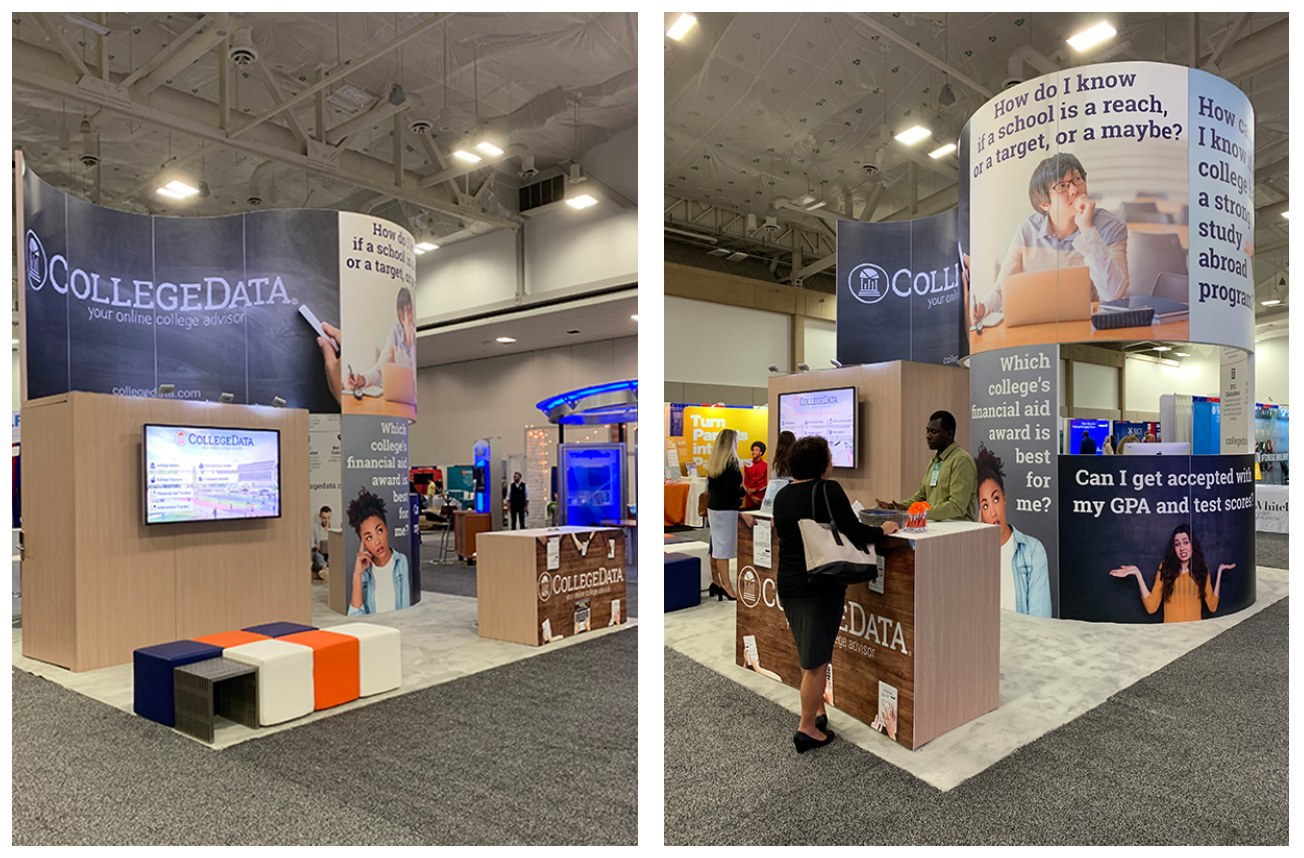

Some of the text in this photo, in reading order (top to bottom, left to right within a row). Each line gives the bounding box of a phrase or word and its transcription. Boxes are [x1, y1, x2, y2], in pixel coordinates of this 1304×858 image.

[993, 72, 1136, 119] How do I know
[1198, 95, 1236, 127] How
[977, 94, 1168, 154] if a school is a reach,
[973, 120, 1183, 178] or a target, or a maybe?
[1198, 126, 1247, 164] I know
[1198, 160, 1248, 195] college
[1198, 191, 1210, 208] a
[373, 222, 396, 240] How
[1198, 220, 1243, 251] study
[353, 237, 374, 253] if a
[346, 258, 372, 271] or a
[1198, 248, 1248, 278] abroad
[49, 254, 292, 312] COLLEGEDATA
[88, 305, 246, 331] your online college advisor
[1000, 352, 1051, 372] Which
[988, 377, 1051, 398] college's
[971, 400, 1051, 419] financial aid
[380, 422, 407, 435] Which
[690, 414, 726, 428] Turn
[188, 432, 255, 447] COLLEGEDATA
[988, 424, 1051, 441] award is
[346, 456, 396, 469] financial
[1015, 448, 1051, 464] best
[372, 475, 401, 487] award
[1026, 471, 1051, 488] for
[1075, 469, 1114, 486] Can
[1119, 470, 1127, 486] I
[1132, 470, 1163, 491] get
[1166, 468, 1234, 490] accepted
[1016, 496, 1051, 512] me?
[1073, 500, 1105, 518] my
[1110, 498, 1151, 514] GPA
[1156, 496, 1190, 514] and
[1193, 496, 1222, 513] test
[552, 567, 625, 595] COLLEGEDATA
